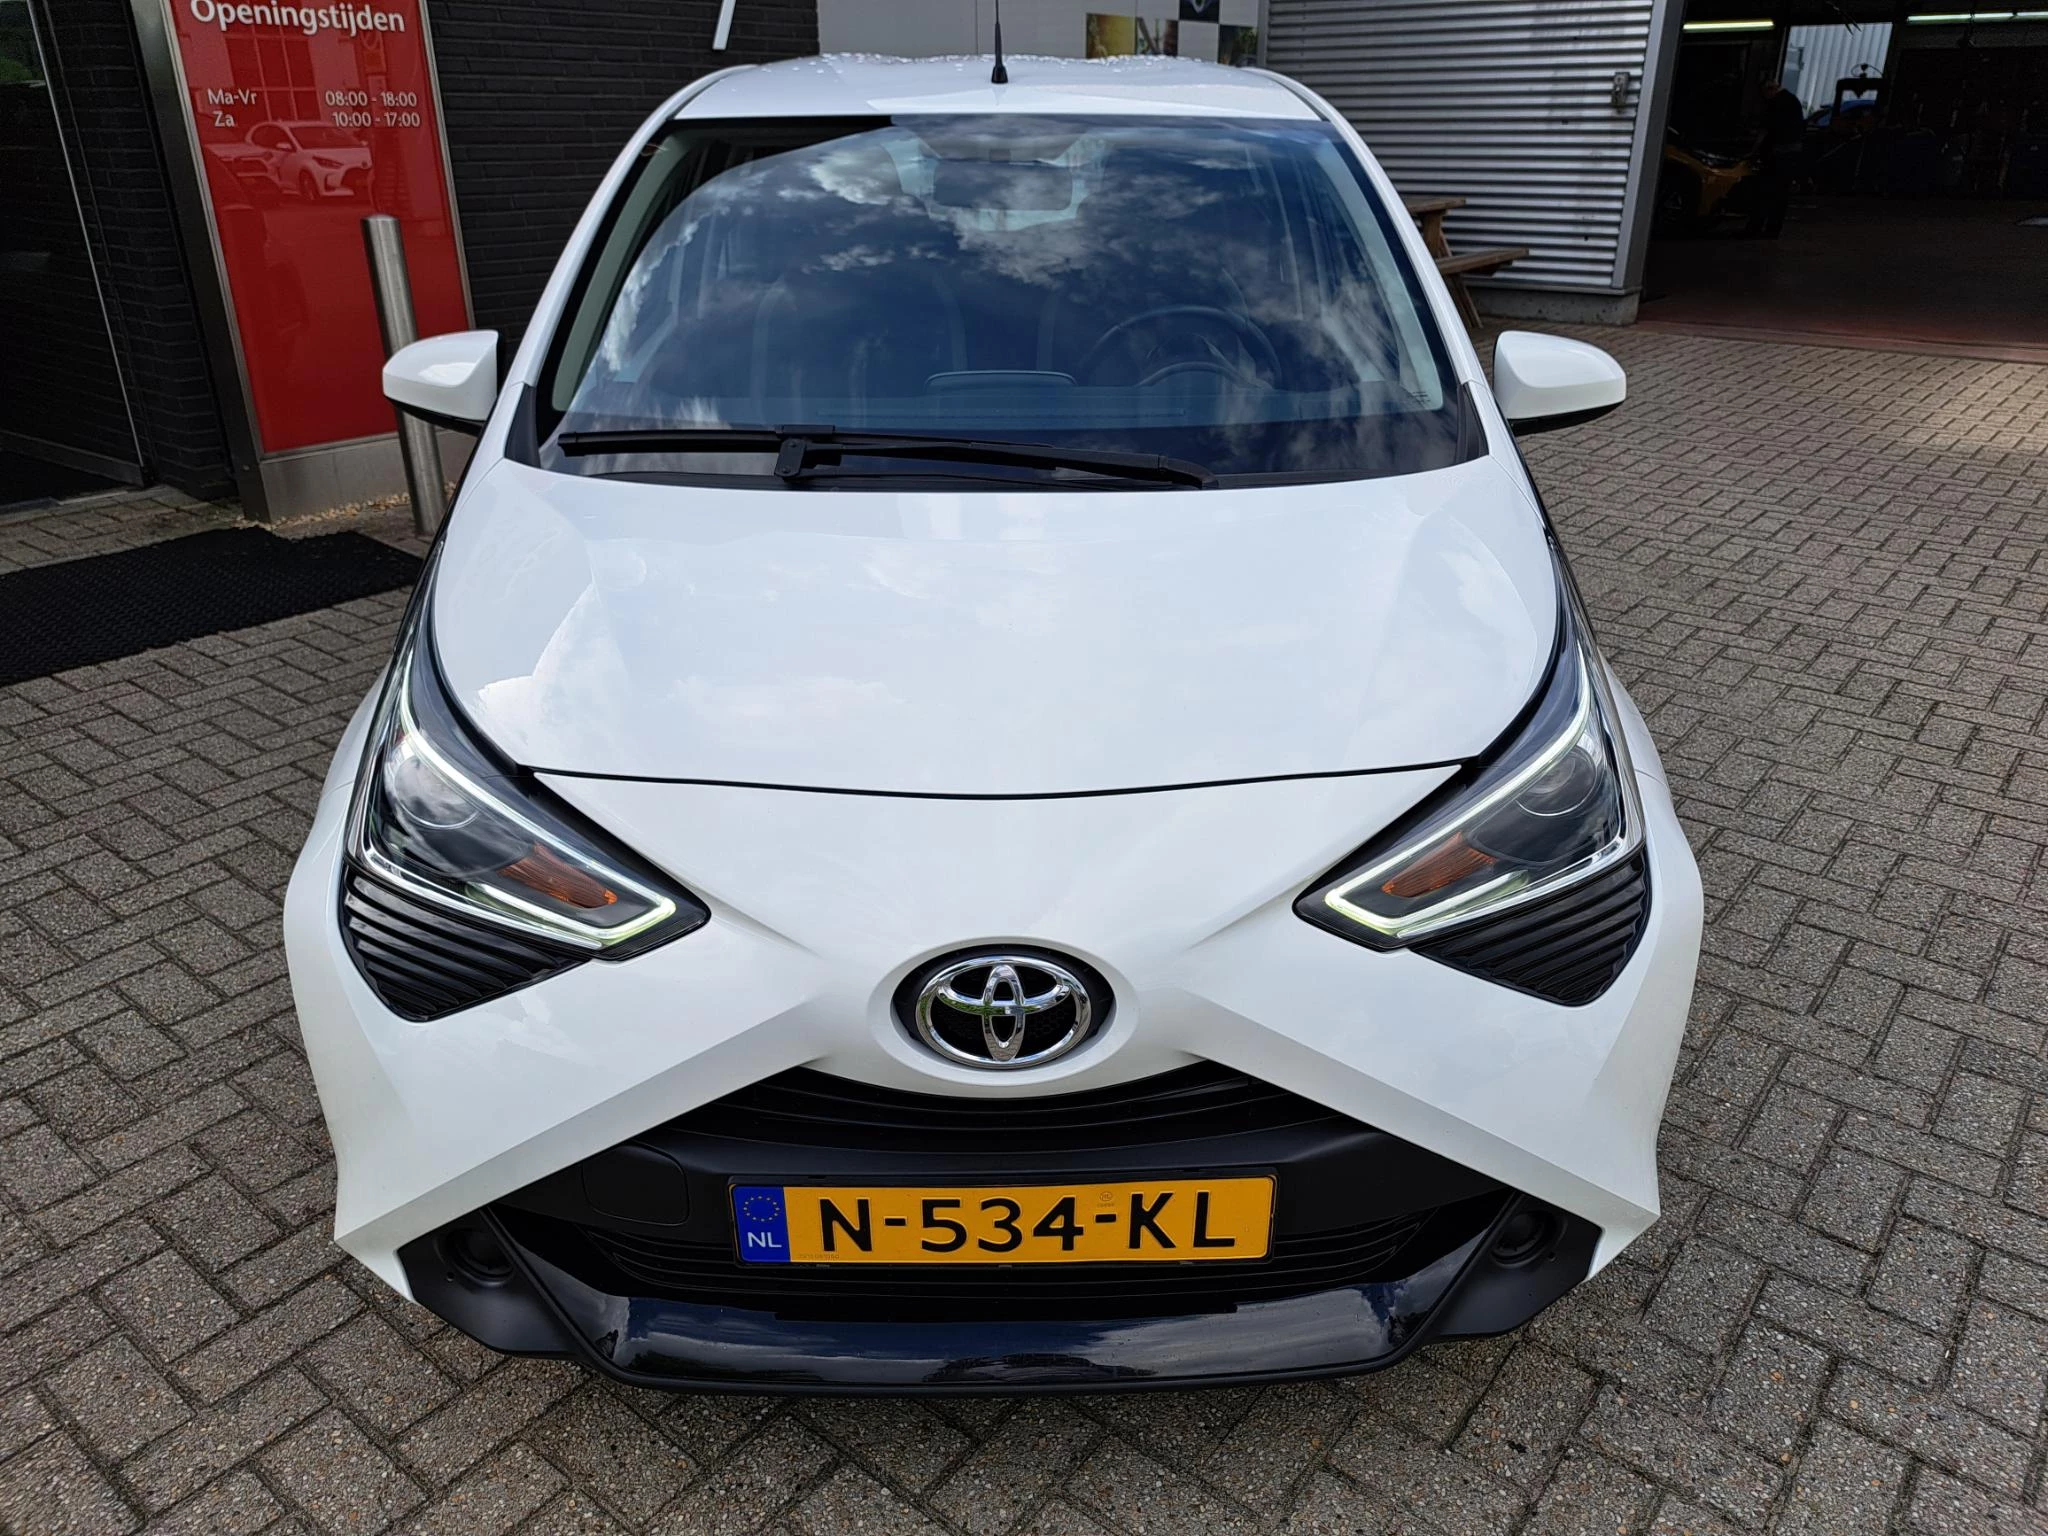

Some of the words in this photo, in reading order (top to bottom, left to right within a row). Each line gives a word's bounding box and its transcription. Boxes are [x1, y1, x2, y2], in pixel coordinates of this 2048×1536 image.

[190, 0, 405, 36] Openingstijden
[207, 87, 257, 105] Ma-Vr
[325, 90, 368, 106] 08:00
[381, 91, 417, 107] 18:00
[213, 110, 235, 127] Za
[332, 111, 372, 127] 10:00
[384, 112, 420, 128] 17:00
[819, 1191, 1236, 1253] N-534-KL
[747, 1231, 782, 1248] NL
